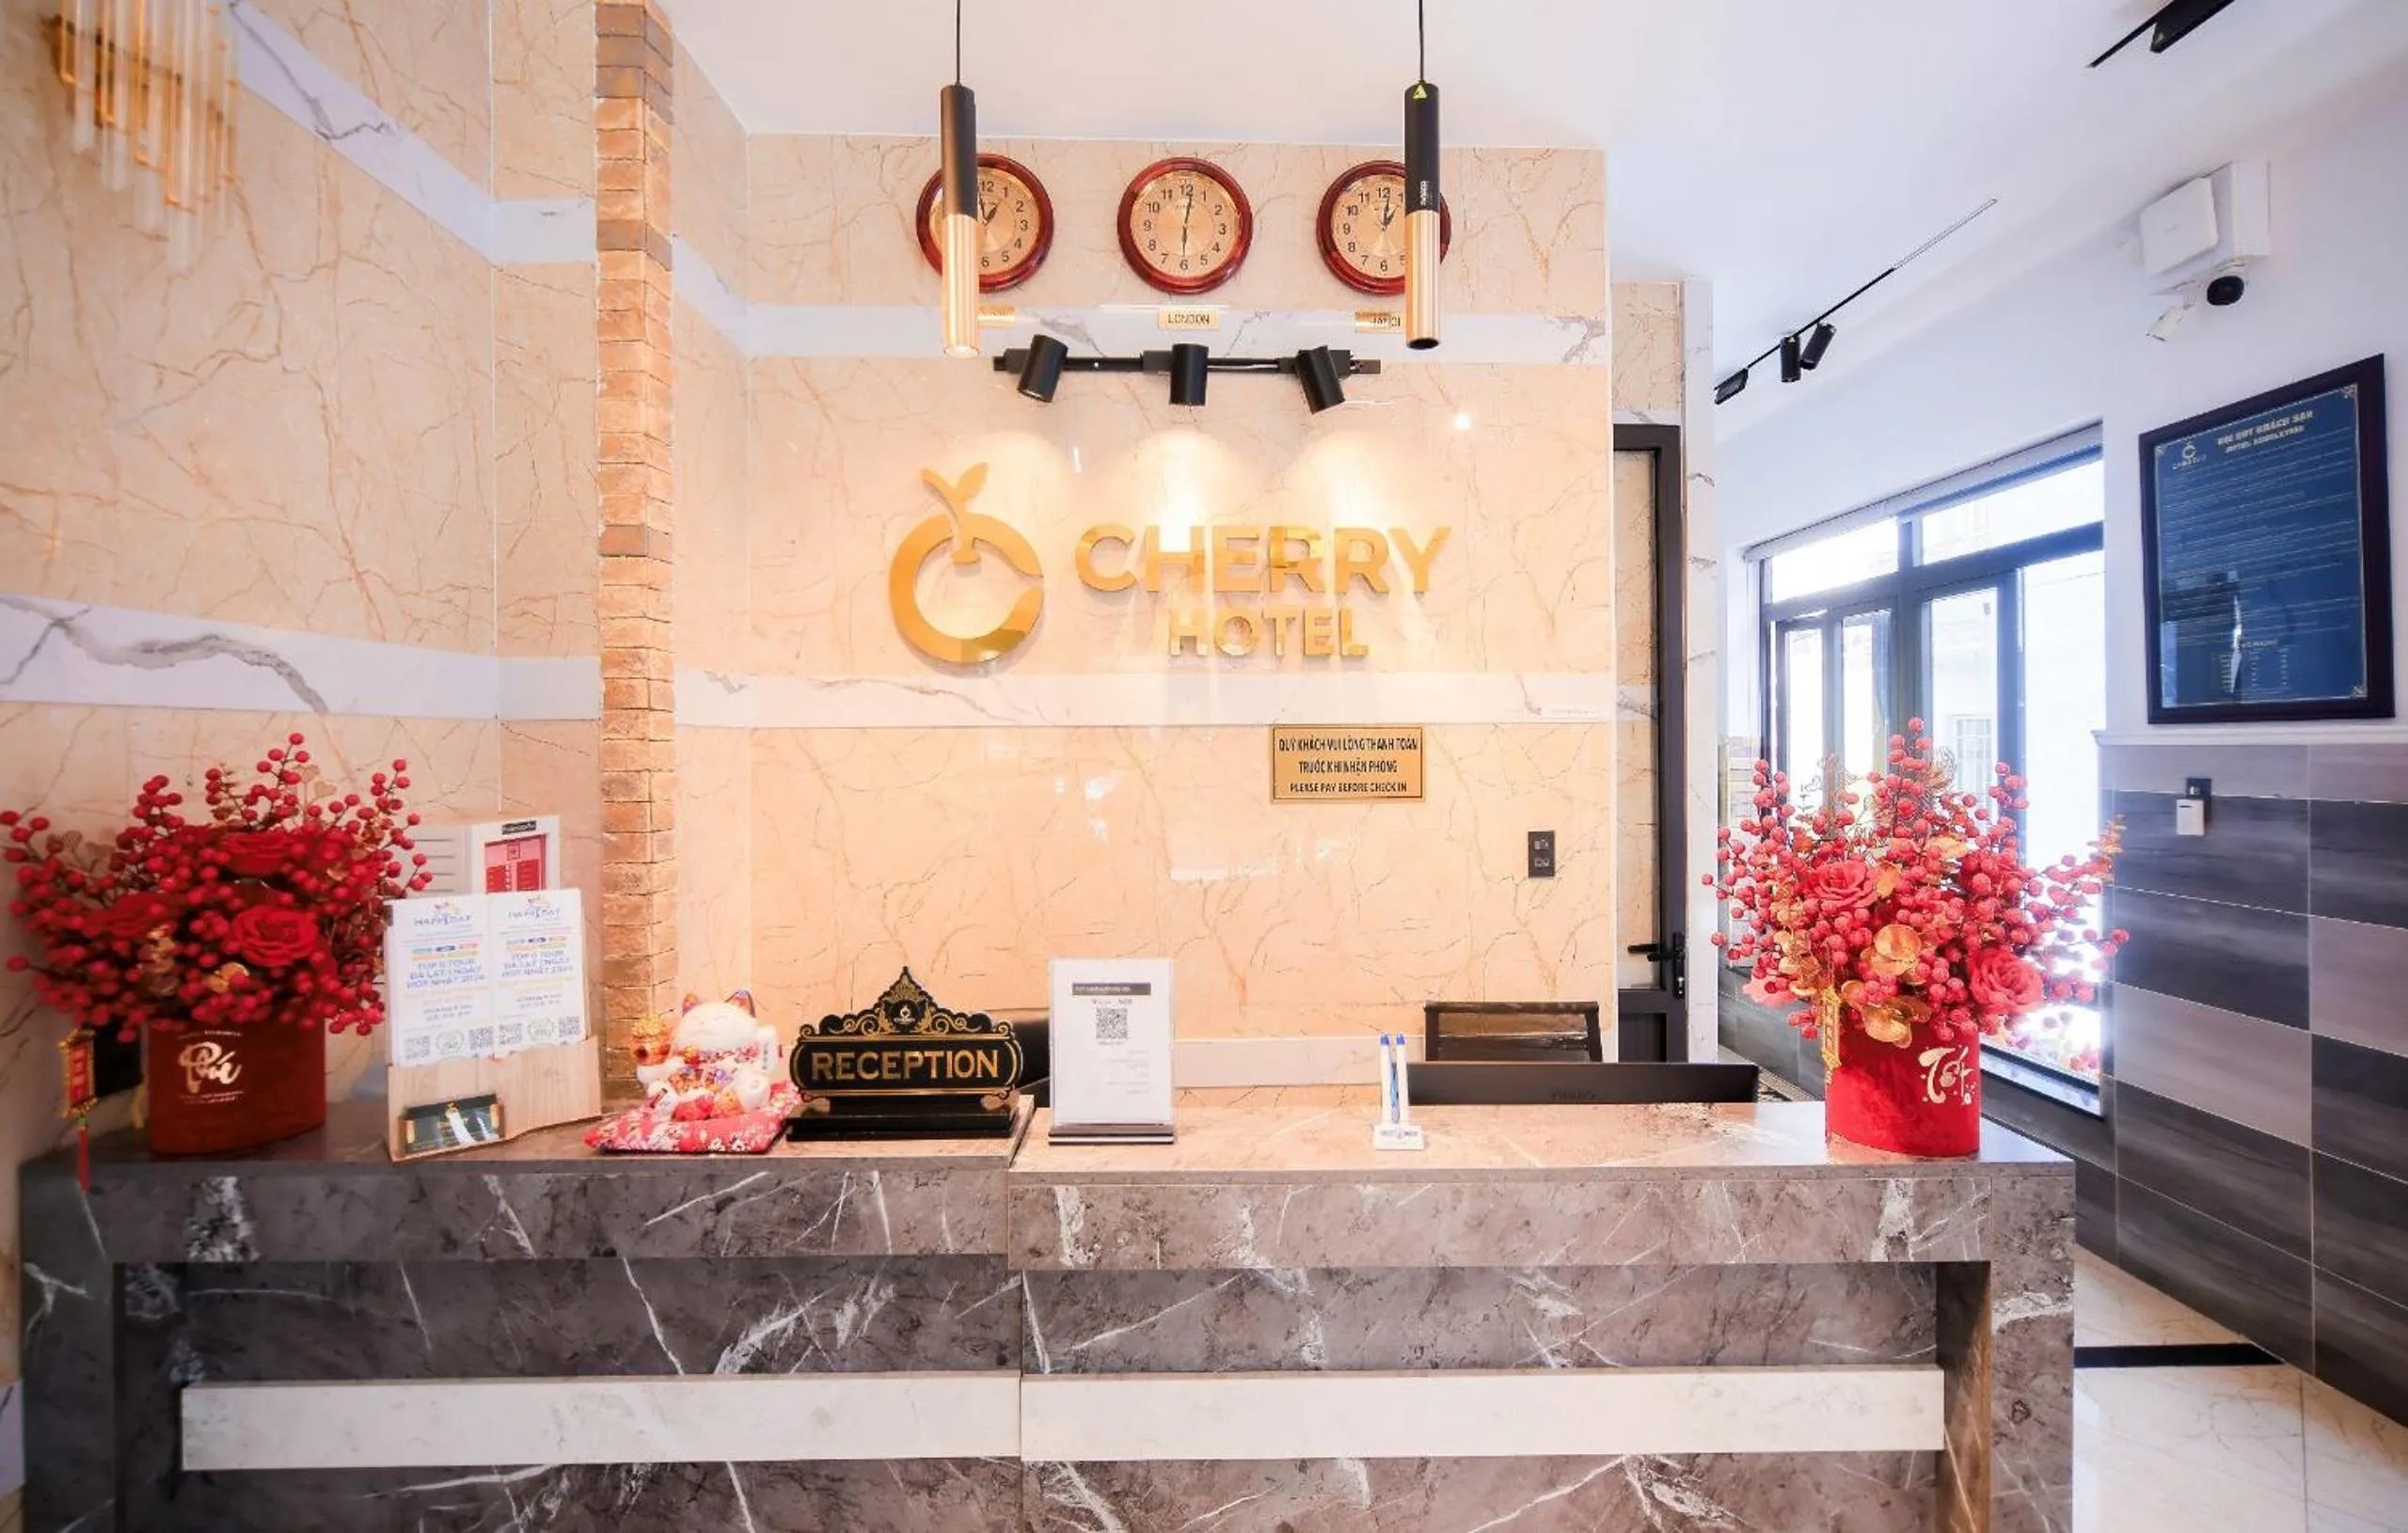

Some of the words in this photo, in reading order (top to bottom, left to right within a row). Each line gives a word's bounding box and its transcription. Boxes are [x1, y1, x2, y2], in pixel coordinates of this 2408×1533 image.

[981, 181, 994, 193] 12
[1180, 184, 1194, 196] 12
[1377, 187, 1391, 198] 12
[1003, 187, 1008, 199] 1
[1162, 189, 1173, 200] 11
[1201, 190, 1207, 201] 1
[1357, 192, 1370, 203] 11
[1016, 200, 1024, 213] 2
[1148, 202, 1160, 213] 10
[1214, 204, 1223, 215] 2
[1346, 205, 1359, 216] 10
[1021, 220, 1028, 231] 3
[1143, 220, 1152, 231] 9
[1218, 223, 1227, 235] 3
[1342, 223, 1351, 235] 9
[1014, 237, 1022, 248] 4
[1148, 240, 1157, 251] 8
[1212, 242, 1221, 253] 4
[1347, 241, 1355, 253] 8
[981, 256, 990, 268] 6
[1002, 251, 1010, 262] 5
[1160, 253, 1169, 264] 7
[1200, 254, 1209, 265] 5
[1360, 255, 1369, 266] 7
[1180, 259, 1189, 271] 6
[1380, 260, 1388, 272] 6
[1167, 313, 1211, 325] LONDON
[1074, 524, 1451, 594] CHERRY
[1168, 606, 1369, 658] HOTEL
[1366, 737, 1394, 751] THANH
[1290, 782, 1318, 792] PLEASE
[1321, 782, 1336, 792] PAY
[1338, 782, 1368, 792] BEFORE
[1370, 782, 1396, 792] CHECK
[1397, 782, 1407, 792] IN
[811, 1049, 998, 1081] RECEPTION
